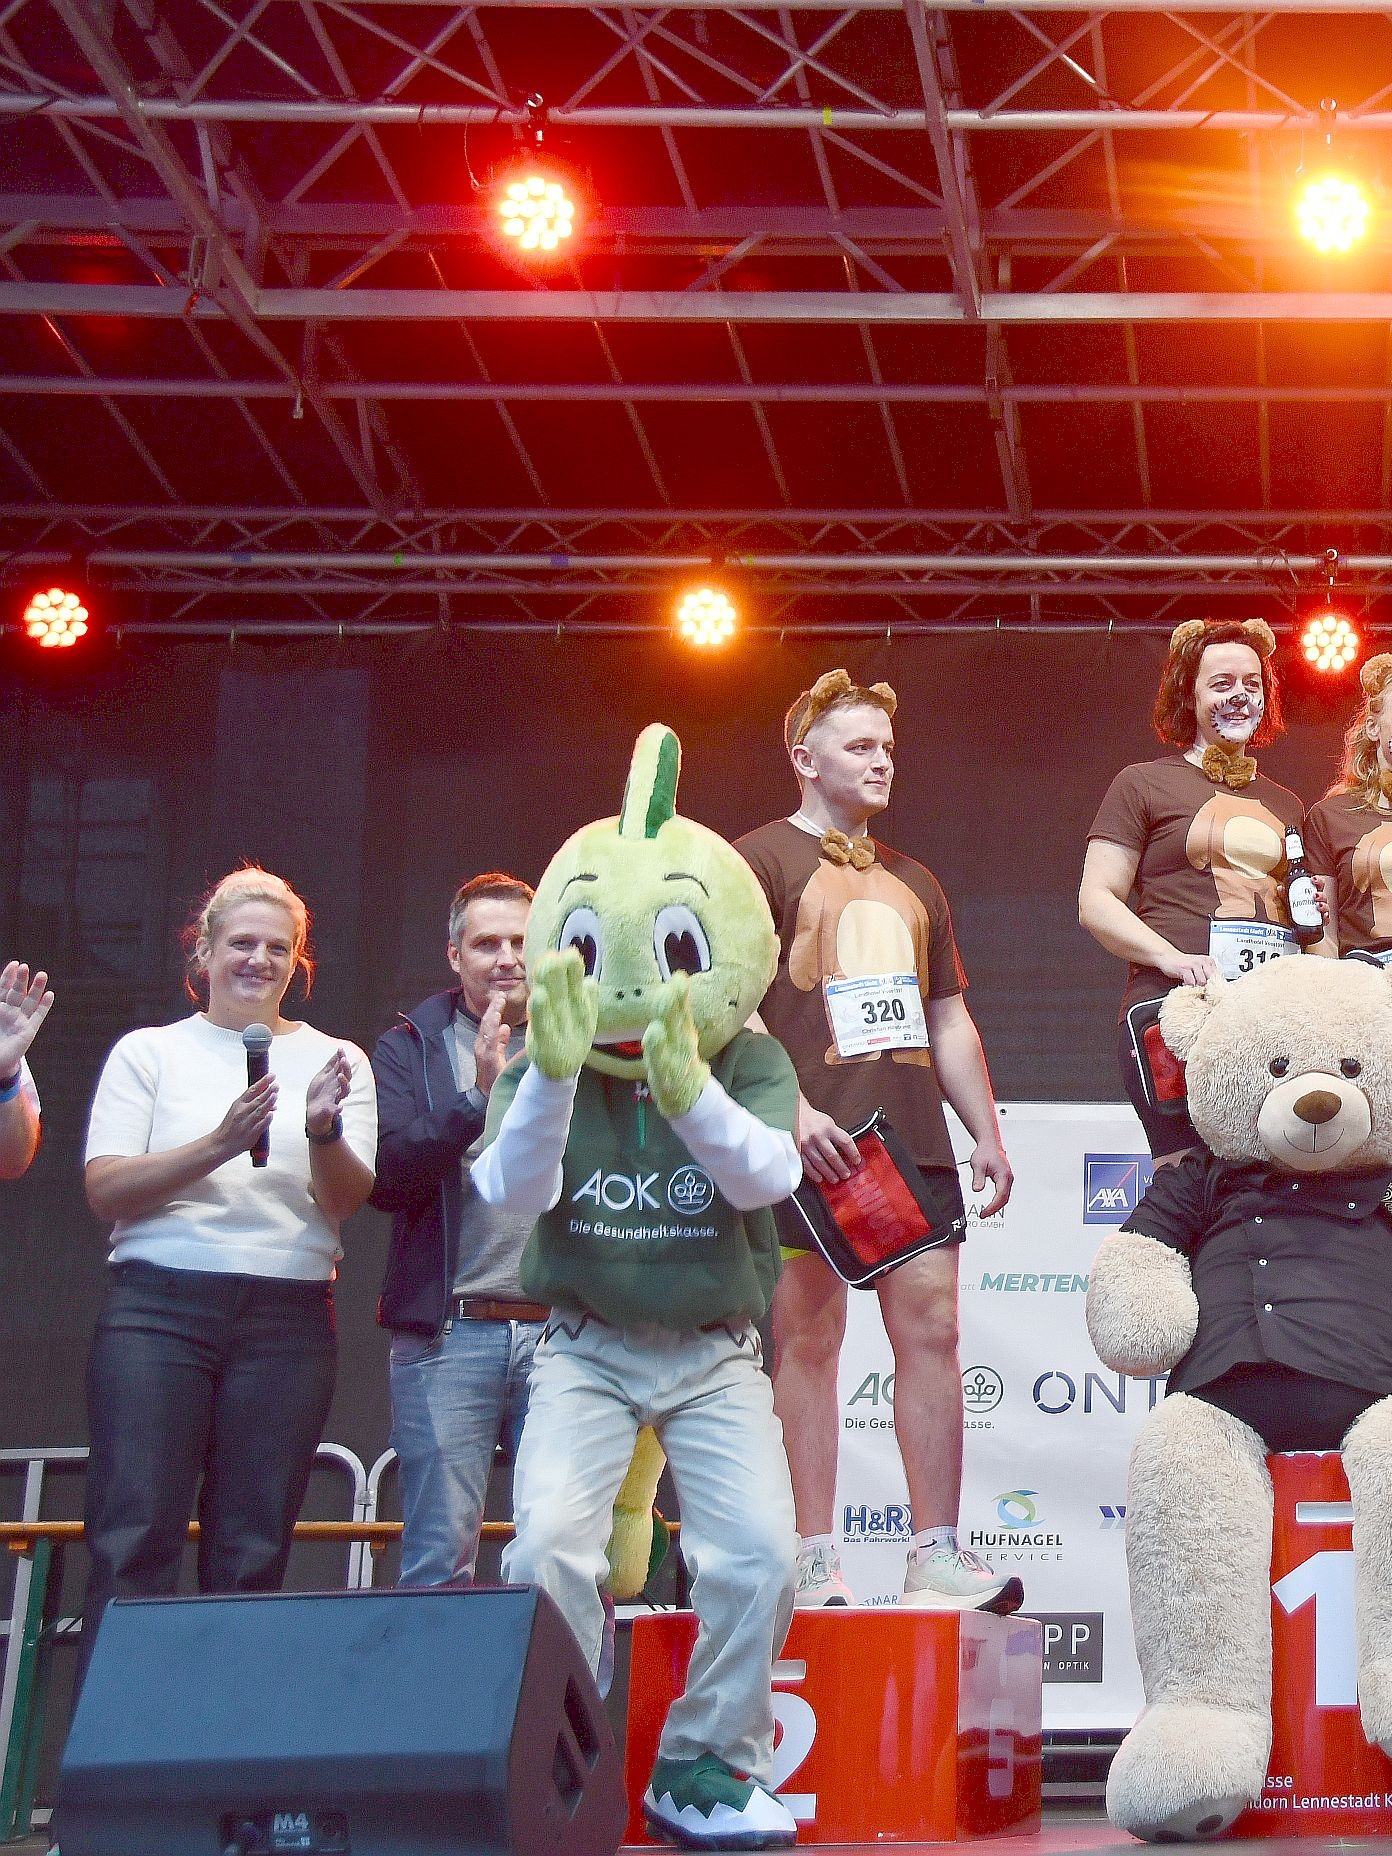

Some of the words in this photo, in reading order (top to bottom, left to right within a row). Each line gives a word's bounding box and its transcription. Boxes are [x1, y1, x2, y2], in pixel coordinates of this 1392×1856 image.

[1239, 949, 1281, 972] 31
[861, 999, 906, 1024] 320
[571, 1168, 661, 1211] AOK
[1089, 1188, 1129, 1208] AXA
[570, 1219, 591, 1234] Die
[845, 1417, 866, 1429] Die
[844, 1505, 910, 1536] H&R
[970, 1531, 1063, 1546] HUFNAGEL
[1272, 1550, 1358, 1706] 1
[1058, 1661, 1090, 1671] OPTIK
[1293, 1793, 1381, 1809] Lennestadt
[272, 1812, 310, 1833] M4
